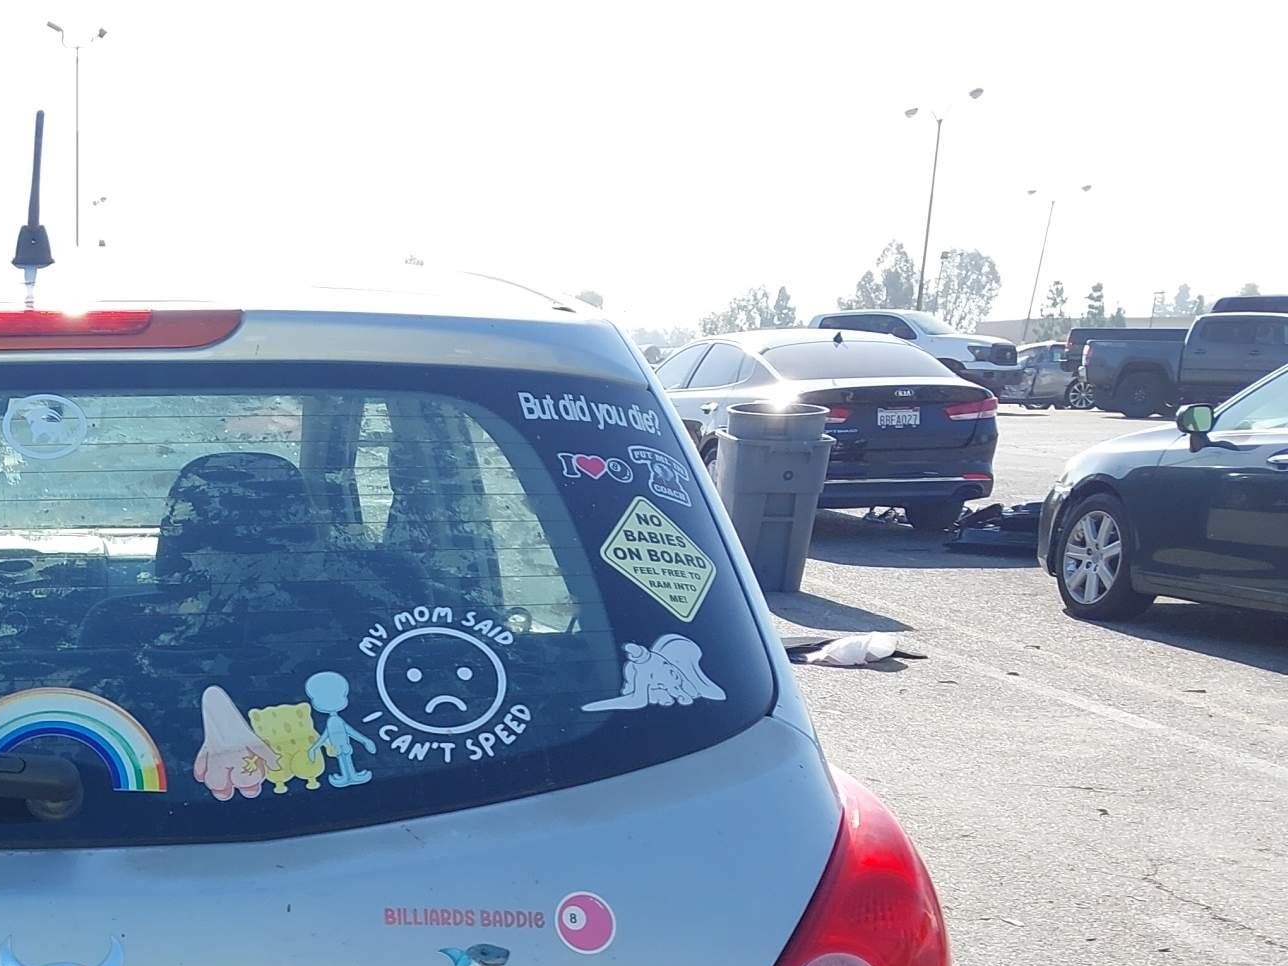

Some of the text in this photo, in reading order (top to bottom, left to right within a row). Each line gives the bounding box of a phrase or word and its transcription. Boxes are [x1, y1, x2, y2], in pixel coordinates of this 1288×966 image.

[518, 392, 662, 436] But did you die?
[635, 512, 662, 527] NO
[623, 529, 686, 548] BABIES
[613, 547, 707, 570] ON BOARD
[633, 566, 701, 580] FEEL FREE TO
[649, 580, 697, 592] RAM INTO
[669, 594, 688, 604] ME!
[359, 606, 514, 657] MY MOM SAID
[362, 704, 531, 763] I CAN'T SPEED
[384, 908, 475, 927] BILLIARDS
